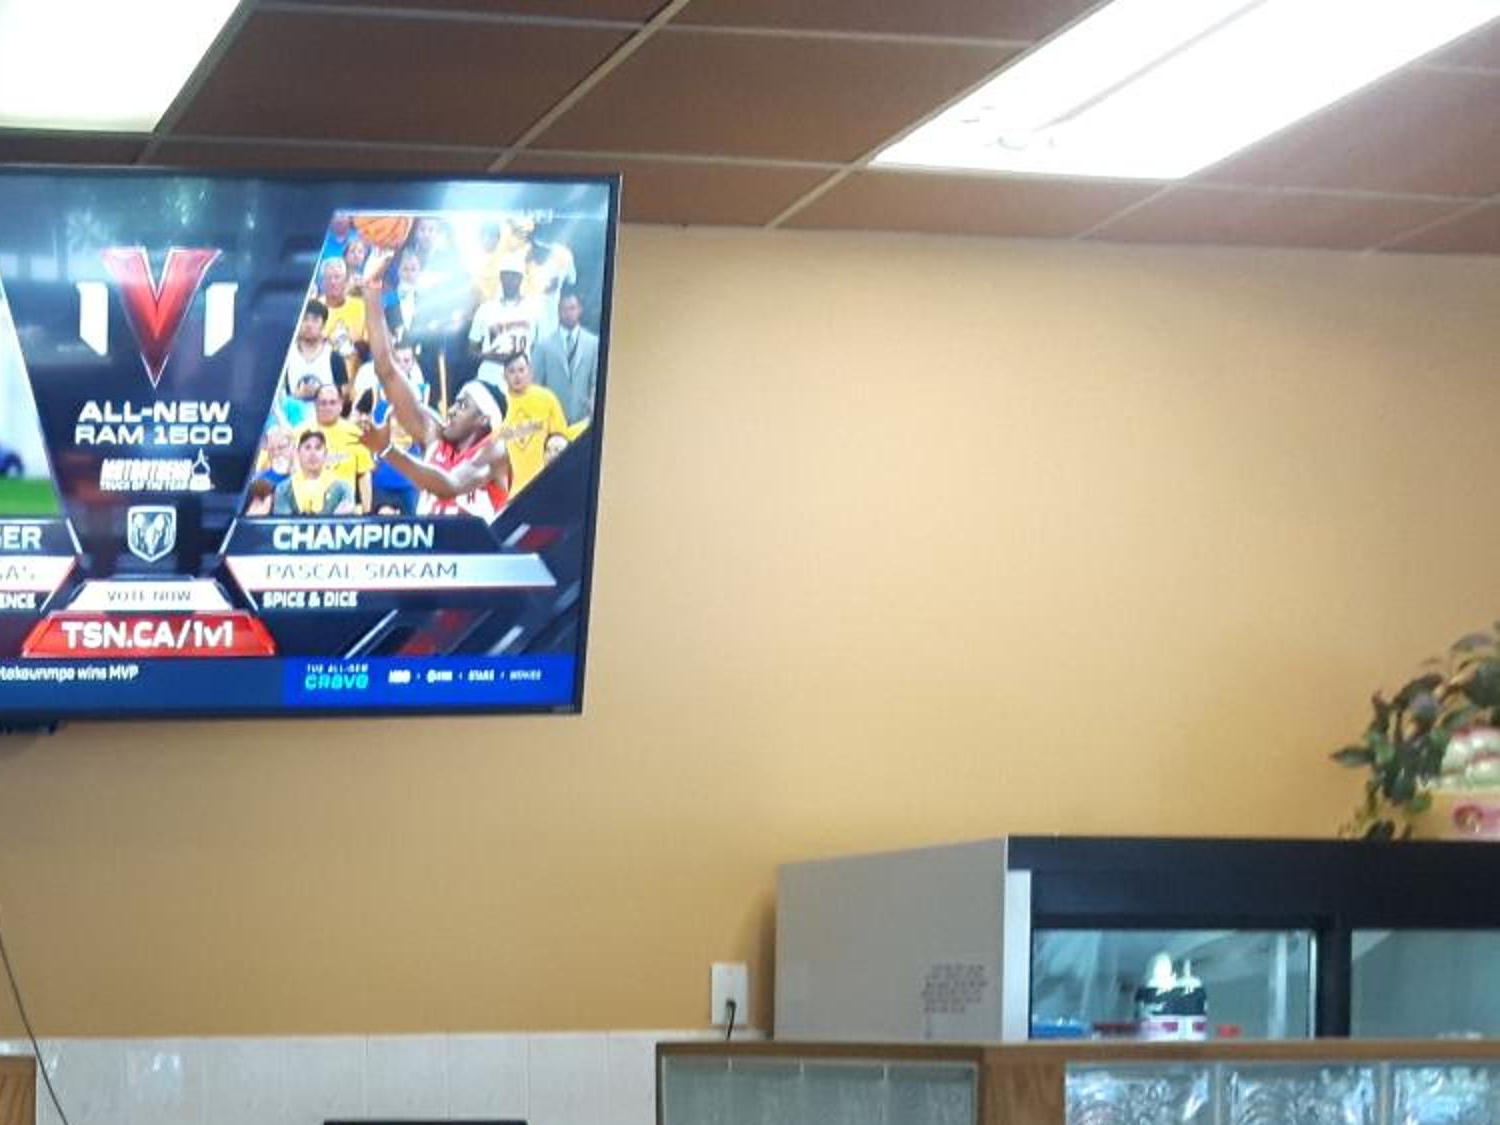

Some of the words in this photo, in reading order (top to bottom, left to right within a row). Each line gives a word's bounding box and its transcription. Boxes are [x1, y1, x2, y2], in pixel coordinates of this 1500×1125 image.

[78, 400, 231, 423] ALL-NEW
[74, 424, 145, 446] RAM
[153, 424, 234, 446] 1500
[273, 523, 435, 550] CHAMPION
[266, 562, 351, 581] PASCAL
[365, 561, 459, 580] SIAKAM
[107, 589, 145, 602] VOTE
[153, 589, 192, 602] NOW
[263, 591, 305, 608] SPICE
[307, 591, 322, 608] &
[323, 591, 358, 608] DICE
[61, 619, 234, 650] TSN.CA/1v1
[78, 665, 106, 681] wins
[109, 664, 139, 681] MVP
